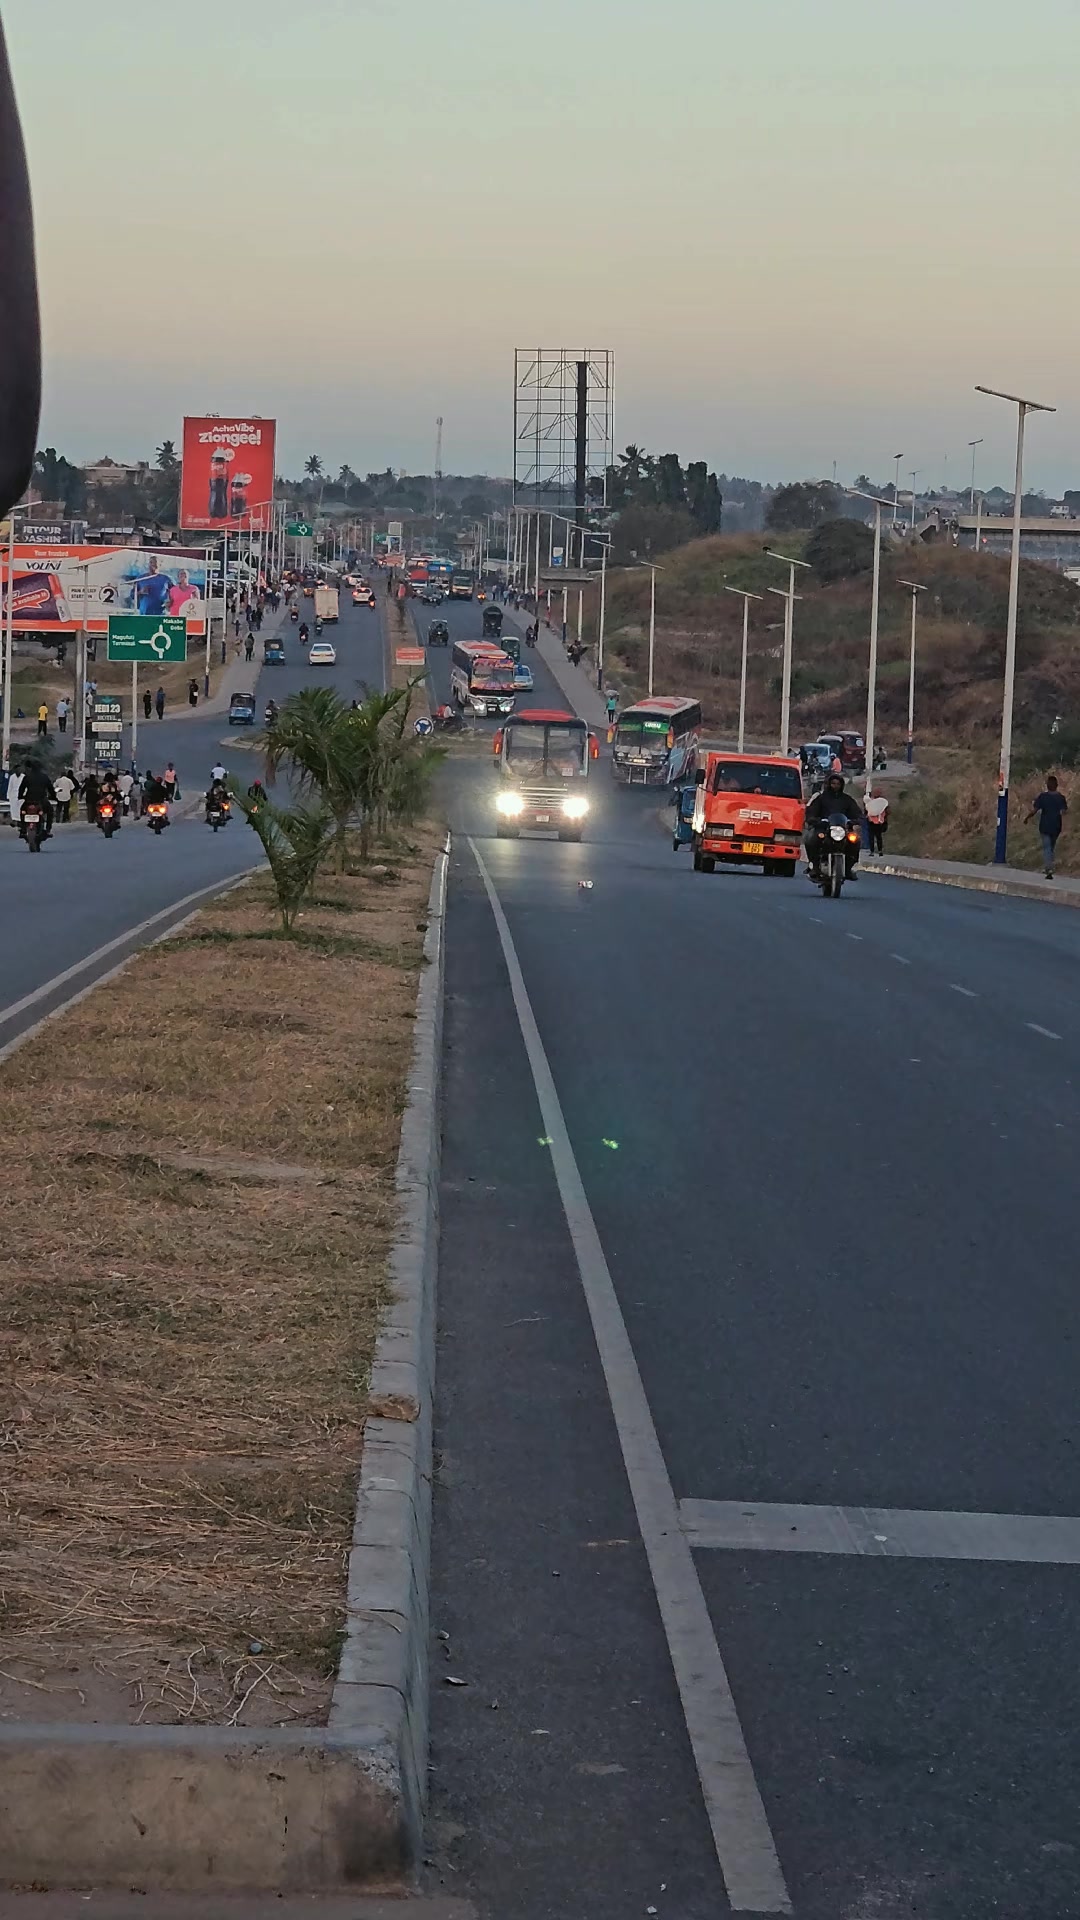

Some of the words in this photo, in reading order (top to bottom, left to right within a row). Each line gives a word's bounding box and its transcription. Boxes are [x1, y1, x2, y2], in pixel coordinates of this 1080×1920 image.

[199, 430, 261, 447] Ziongee!
[23, 525, 61, 534] JETOUR
[103, 588, 114, 603] 2
[110, 704, 121, 713] 23
[110, 741, 121, 750] 23
